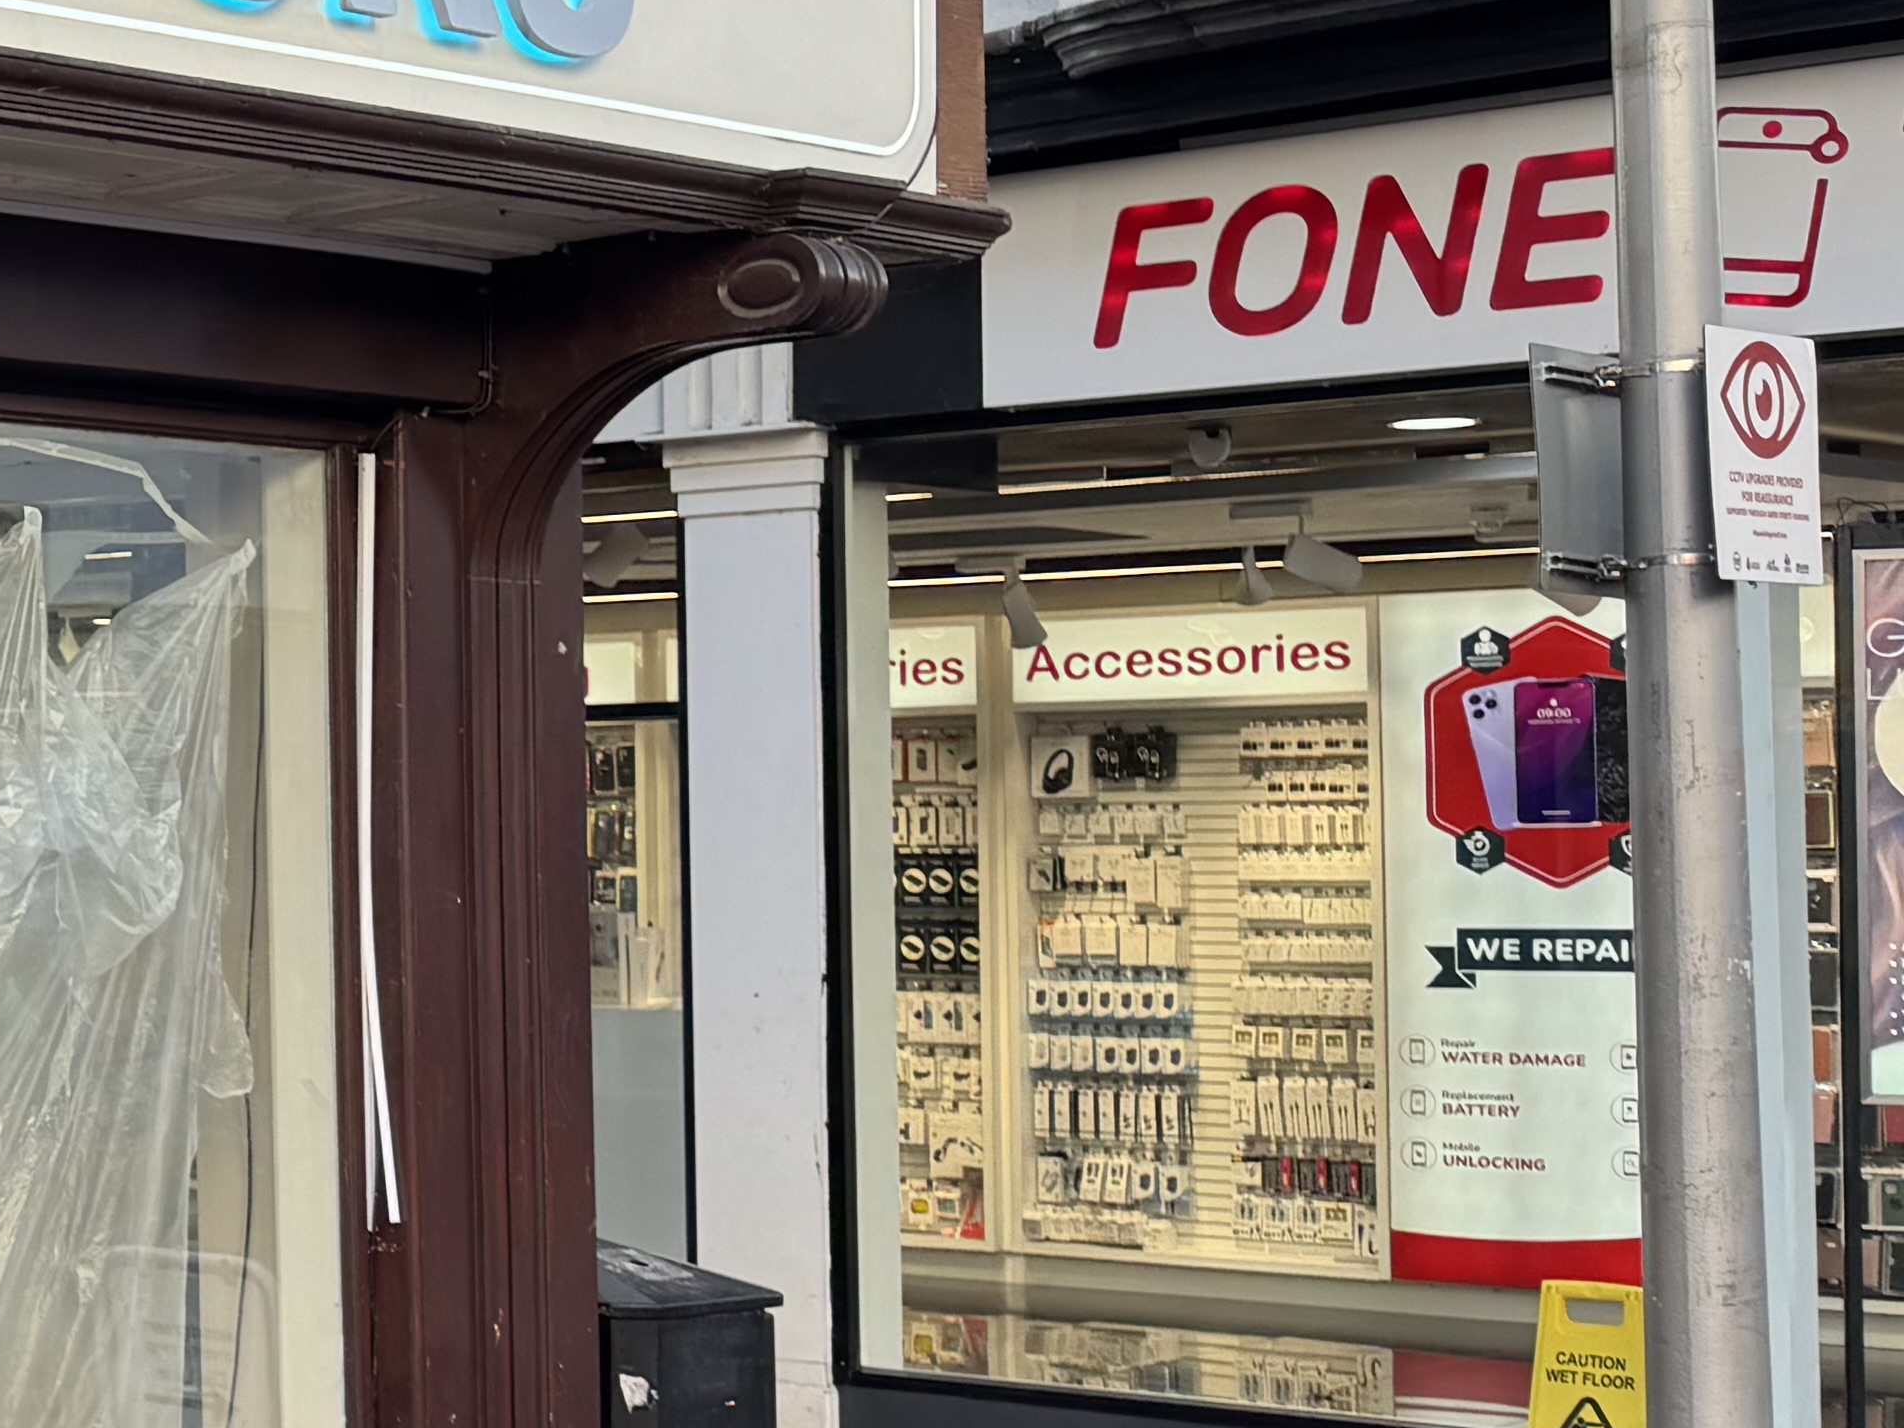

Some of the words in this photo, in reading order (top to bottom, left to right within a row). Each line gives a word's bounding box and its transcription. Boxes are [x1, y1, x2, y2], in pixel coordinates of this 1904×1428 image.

[1093, 146, 1615, 350] FONE
[1026, 633, 1352, 683] Accessories
[1465, 937, 1522, 962] WE
[1441, 1050, 1504, 1066] WATER
[1508, 1051, 1586, 1068] DAMAGE
[1441, 1089, 1515, 1103] Replacement
[1441, 1102, 1521, 1119] BATTERY
[1442, 1153, 1547, 1173] UNLOCKING
[1555, 1350, 1627, 1372] CAUTION
[1545, 1367, 1579, 1385] WET
[1582, 1371, 1636, 1392] FLOOR
